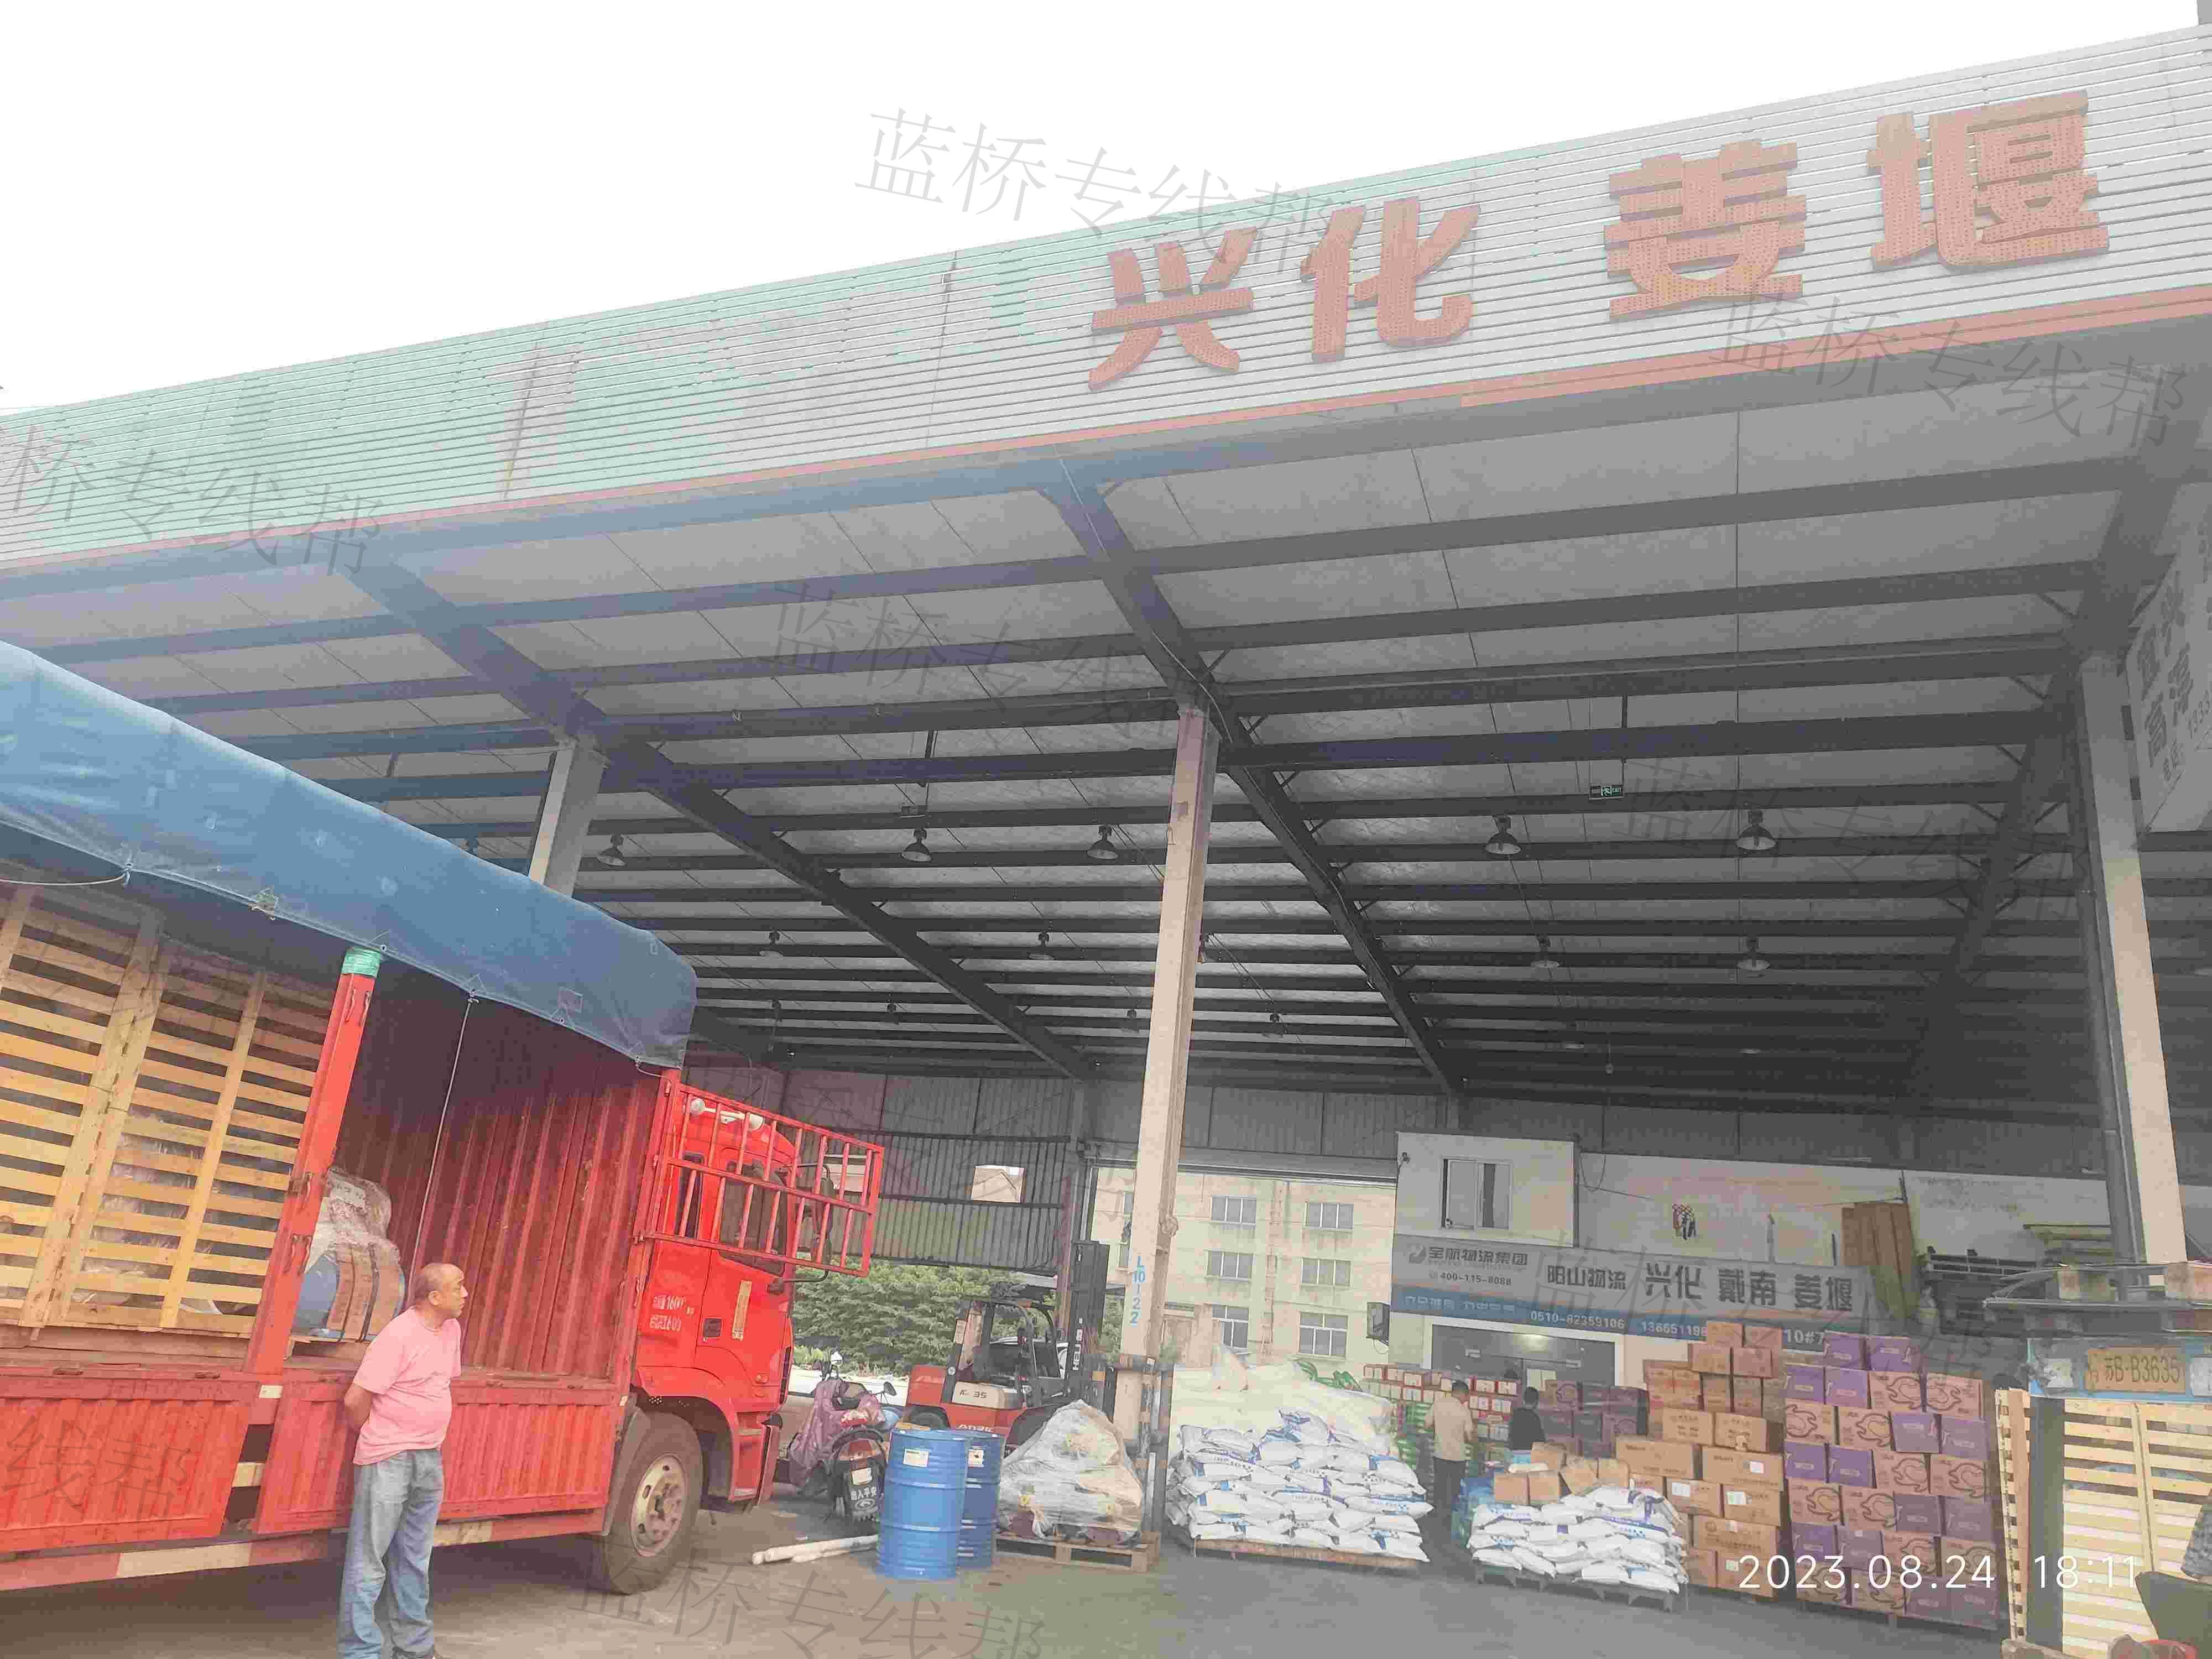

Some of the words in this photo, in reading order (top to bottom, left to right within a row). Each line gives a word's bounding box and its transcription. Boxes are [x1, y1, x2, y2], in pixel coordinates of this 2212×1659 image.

[1088, 196, 1482, 393] 兴化
[1603, 90, 2110, 322] 姜堰
[1645, 1262, 1702, 1300] 兴化
[1717, 1268, 1777, 1306] 戴南
[1793, 1274, 1853, 1312] 姜堰
